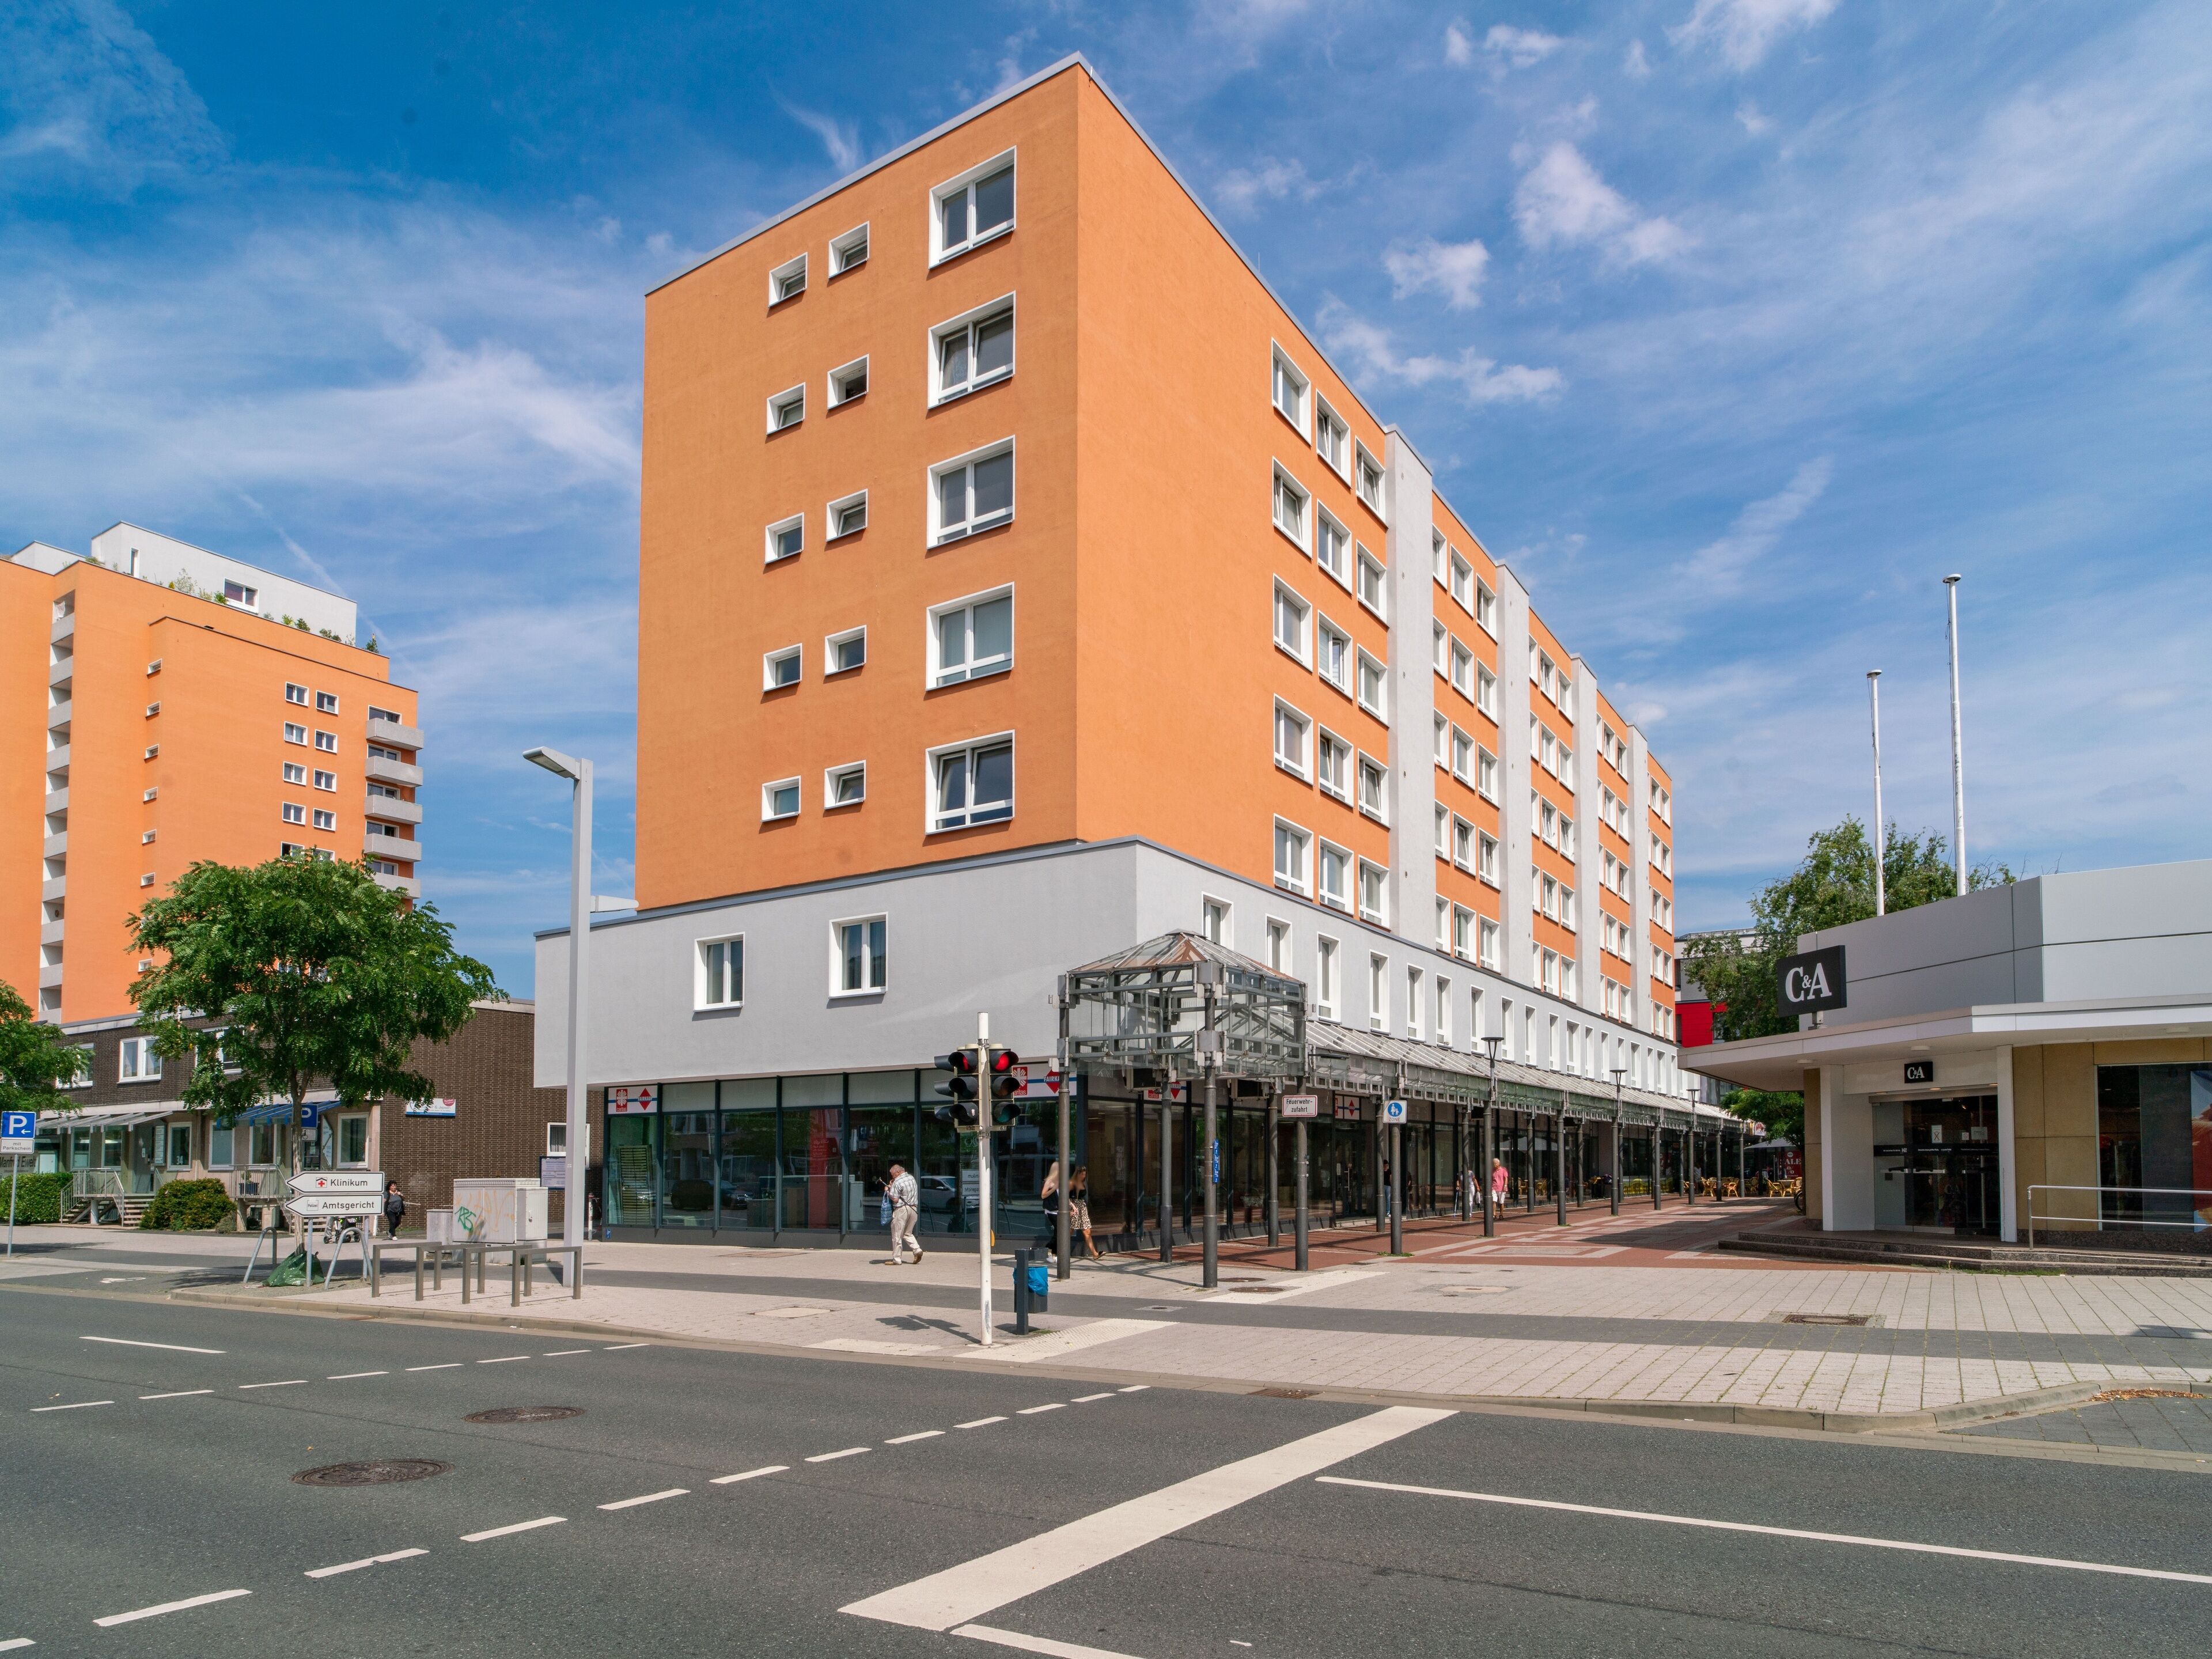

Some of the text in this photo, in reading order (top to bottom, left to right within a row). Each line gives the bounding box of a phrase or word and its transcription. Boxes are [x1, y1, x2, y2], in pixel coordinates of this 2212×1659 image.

[1786, 963, 1832, 1002] C&A
[1907, 1066, 1925, 1079] C&A
[9, 1115, 28, 1135] P
[176, 1156, 183, 1165] 34
[322, 1201, 374, 1210] Amtsgericht
